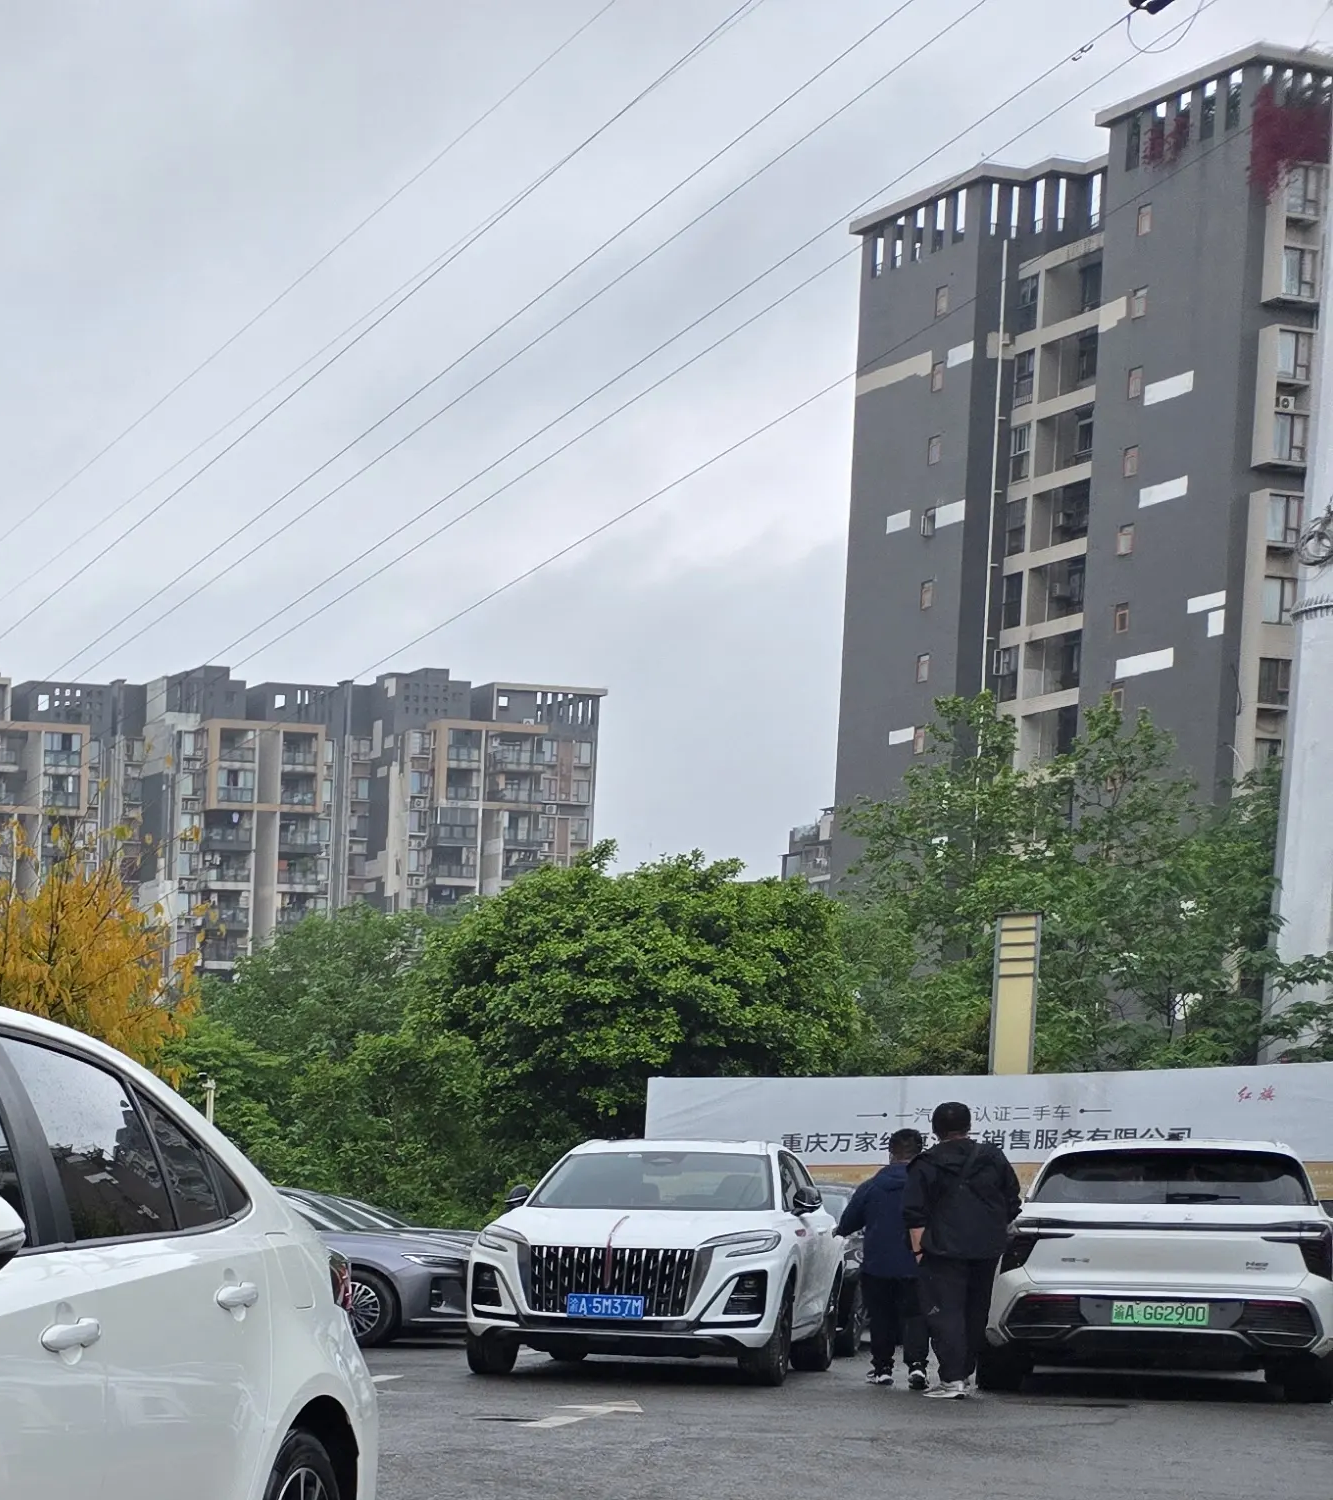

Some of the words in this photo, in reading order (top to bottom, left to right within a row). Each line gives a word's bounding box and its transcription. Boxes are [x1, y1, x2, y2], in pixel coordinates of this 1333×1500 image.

[894, 1104, 1072, 1123] 一汽认证二手车
